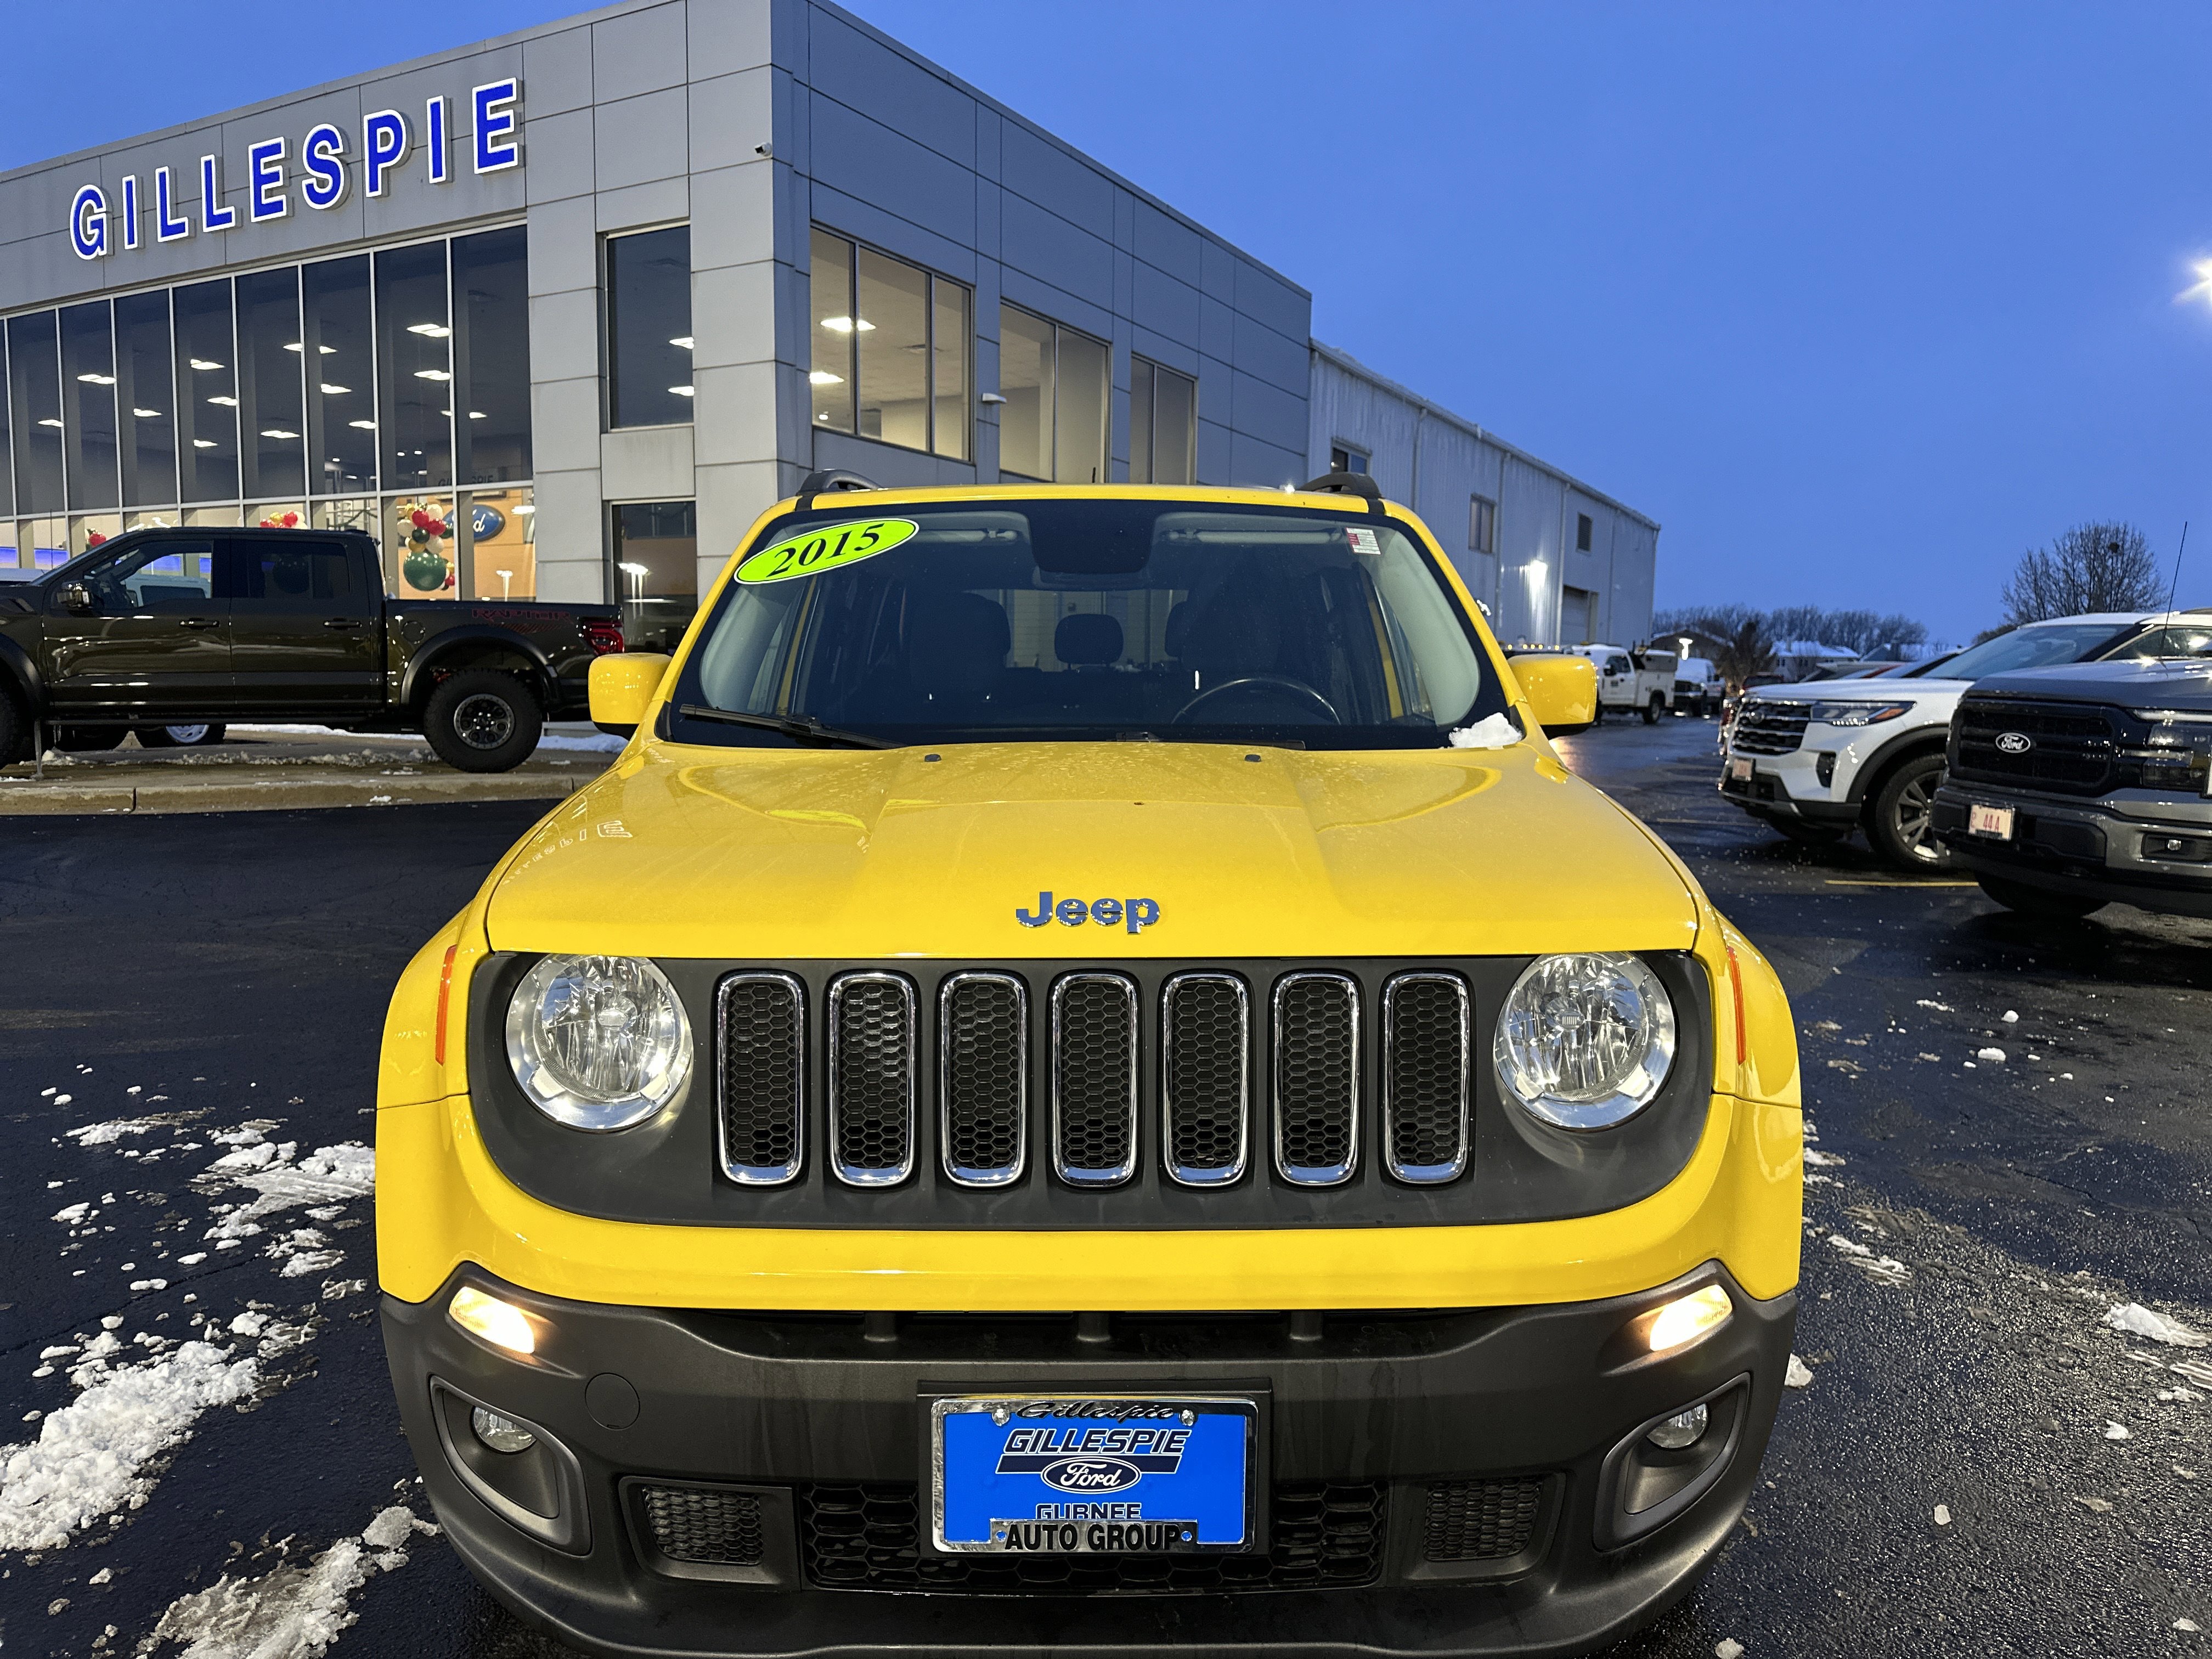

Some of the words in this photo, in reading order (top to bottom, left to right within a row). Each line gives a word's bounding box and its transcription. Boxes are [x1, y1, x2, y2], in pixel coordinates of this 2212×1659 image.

[70, 77, 518, 259] GILLESPIE
[766, 523, 884, 577] 2015
[472, 608, 574, 624] RAPTOR
[2001, 735, 2024, 750] Ford
[1015, 891, 1160, 935] Jeep
[1017, 1401, 1174, 1423] Gillespie
[1003, 1429, 1192, 1454] GILLESPIE
[1060, 1462, 1122, 1486] Ford
[1036, 1503, 1142, 1520] GURNEE
[1005, 1523, 1079, 1550] AUTO
[1087, 1523, 1181, 1551] GROUP
